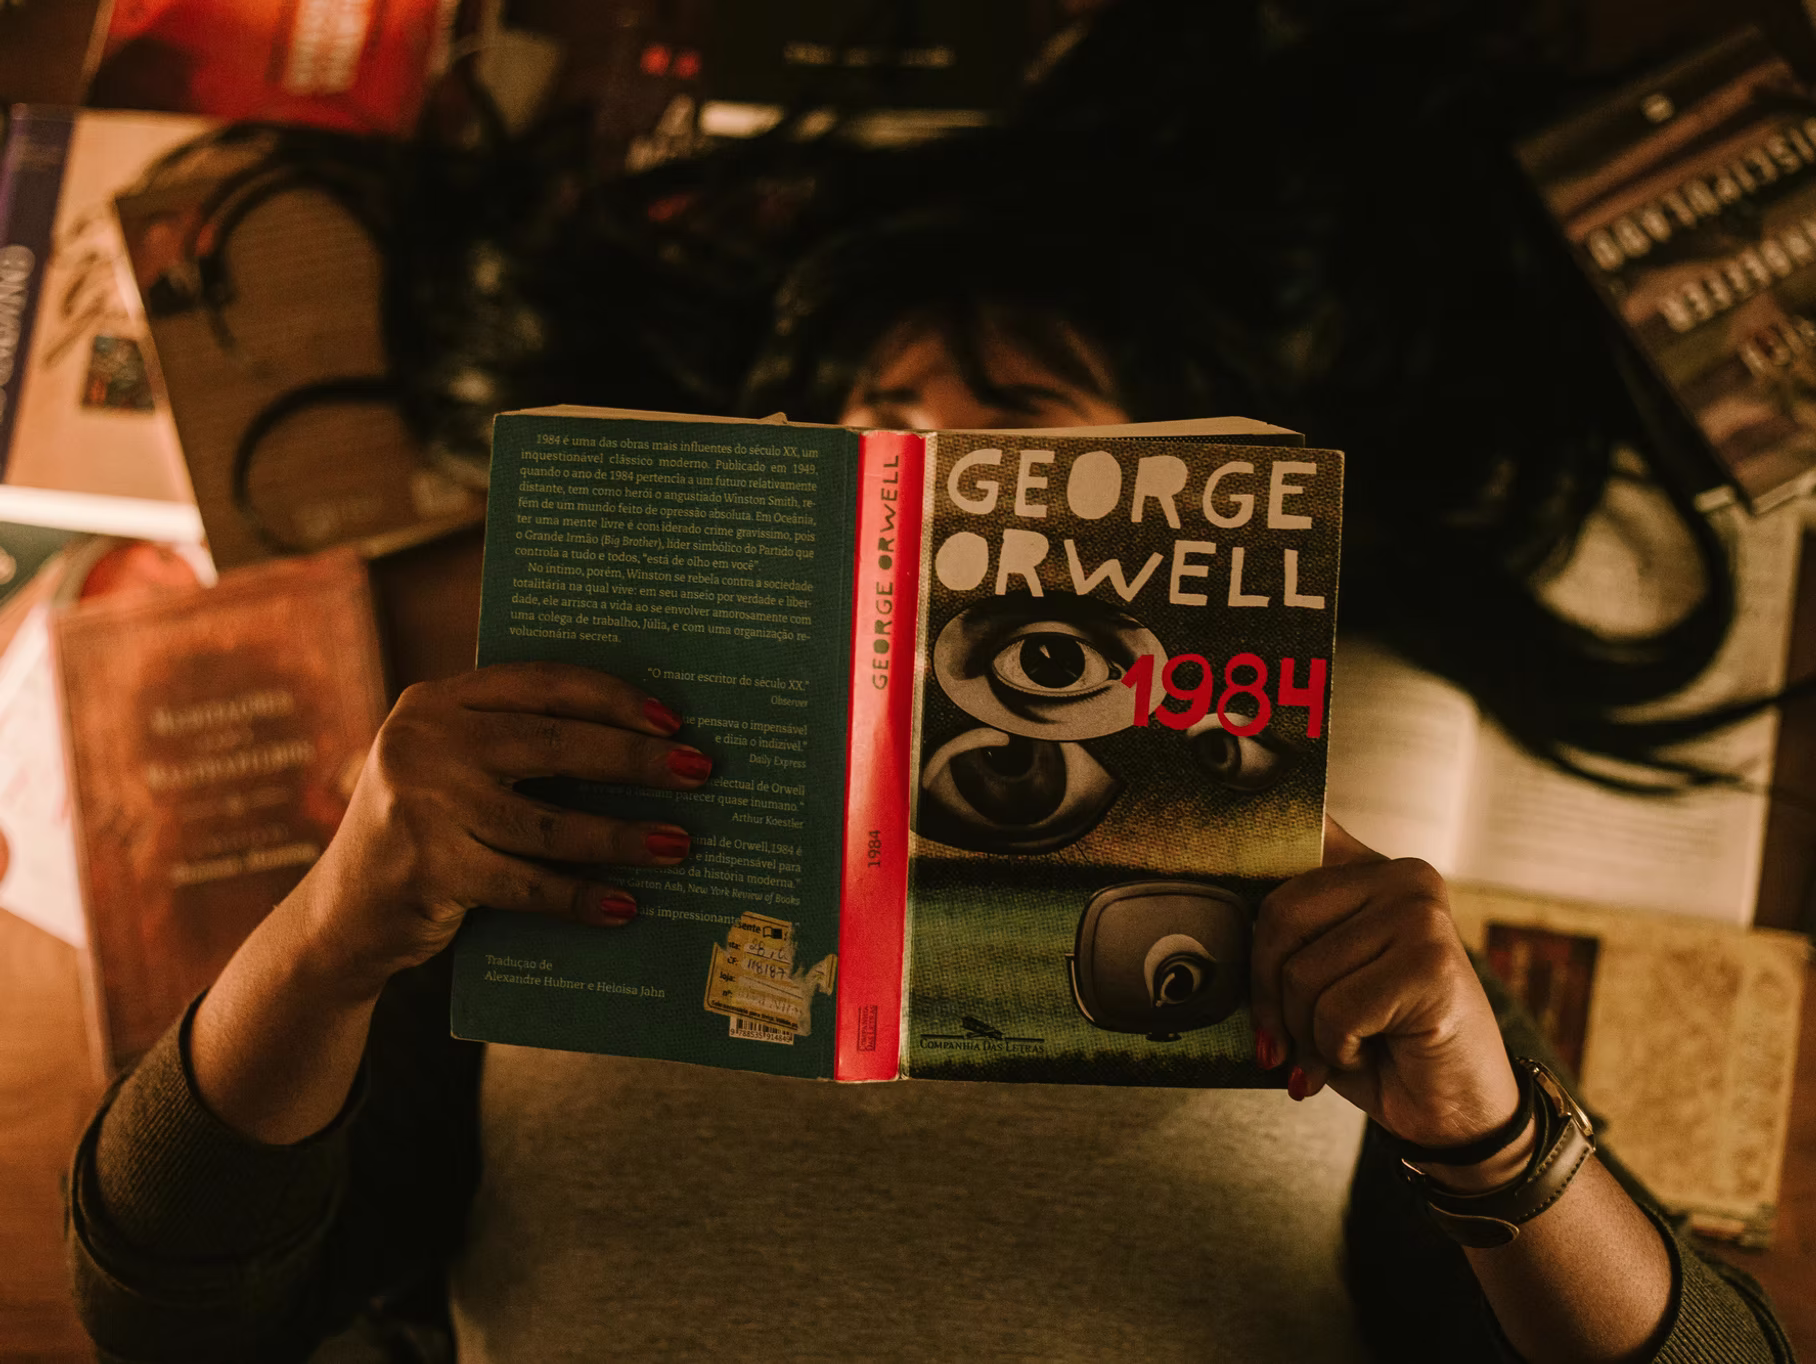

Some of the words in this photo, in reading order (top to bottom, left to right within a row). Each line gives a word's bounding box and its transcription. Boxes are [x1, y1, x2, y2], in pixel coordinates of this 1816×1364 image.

[536, 433, 560, 444] 1984
[572, 437, 595, 446] uma
[598, 436, 617, 447] das
[619, 438, 649, 449] obras
[652, 440, 677, 450] mais
[680, 440, 732, 453] influentes
[748, 444, 780, 456] século
[520, 449, 603, 463] inquestionável
[608, 453, 653, 465] clássico
[715, 459, 765, 471] Publicado
[519, 466, 560, 477] quando
[571, 470, 592, 478] ano
[610, 469, 633, 481] 1984
[636, 473, 685, 483] pertencia
[715, 475, 746, 487] futuro
[748, 477, 817, 490] relativamente
[947, 448, 1317, 530] GEORGE
[568, 485, 589, 494] tem
[591, 487, 622, 496] como
[624, 487, 652, 498] herói
[664, 491, 721, 502] angustiado
[723, 492, 765, 504] Winston
[518, 496, 538, 507] fém
[576, 501, 615, 512] mundo
[618, 502, 642, 514] feito
[659, 507, 706, 518] opressão
[755, 511, 771, 521] Em
[877, 455, 899, 571] ORWELL
[516, 513, 531, 523] ter
[535, 516, 559, 524] uma
[562, 517, 597, 527] mente
[600, 517, 624, 529] livre
[636, 521, 701, 534] considerado
[703, 525, 733, 536] crime
[794, 530, 815, 542] pois
[524, 529, 563, 541] Grande
[566, 532, 598, 543] Irmão
[600, 534, 620, 547] (Big
[666, 538, 690, 549] líder
[692, 540, 741, 553] simbólico
[758, 544, 793, 556] Partido
[795, 549, 814, 559] que
[514, 547, 559, 557] controla
[571, 549, 596, 559] tudo
[686, 556, 710, 567] olho
[527, 561, 543, 572] No
[626, 568, 671, 581] Winston
[687, 573, 719, 584] rebela
[721, 577, 753, 586] contra
[763, 578, 813, 591] sociedade
[935, 528, 1326, 610] ORWELL
[512, 577, 565, 590] totalitária
[585, 582, 608, 594] qual
[658, 589, 677, 597] seu
[680, 589, 714, 600] anseio
[716, 593, 733, 603] por
[736, 593, 776, 604] verdade
[542, 595, 558, 605] ele
[561, 597, 597, 608] arrisca
[609, 599, 632, 610] vida
[664, 605, 709, 616] envolver
[712, 609, 787, 622] amorosamente
[789, 615, 811, 624] com
[509, 625, 576, 639] volucionária
[510, 612, 534, 620] uma
[537, 611, 572, 625] colega
[681, 623, 704, 632] com
[707, 625, 731, 634] uma
[733, 627, 794, 641] organização
[872, 581, 893, 690] GEORGE
[663, 669, 694, 680] maior
[697, 673, 736, 684] escritor
[754, 676, 785, 688] século
[1121, 652, 1327, 739] 1984
[697, 717, 739, 728] pensava
[750, 720, 807, 735] impensável
[723, 733, 747, 745] dizia
[748, 752, 771, 764] Daily
[773, 755, 806, 769] Express
[711, 777, 754, 790] electual
[771, 782, 805, 795] Orwell
[717, 796, 748, 806] quase
[731, 811, 762, 824] Arthur
[765, 814, 803, 828] Koestler
[718, 836, 731, 847] de
[868, 830, 881, 868] 1984
[704, 851, 776, 869] indispensável
[778, 863, 801, 873] para
[687, 867, 701, 877] da
[703, 868, 743, 881] história
[687, 882, 707, 894] New
[710, 885, 729, 896] York
[764, 891, 773, 901] of
[775, 892, 800, 905] Books
[538, 959, 552, 969] de
[484, 970, 541, 985] Alexandre
[543, 976, 584, 989] Hubner
[596, 981, 637, 994] Heloisa
[639, 985, 665, 997] Jahn
[920, 1038, 980, 1051] COMPANHIA
[983, 1040, 1002, 1052] DAS
[1005, 1042, 1044, 1053] LETRAS
